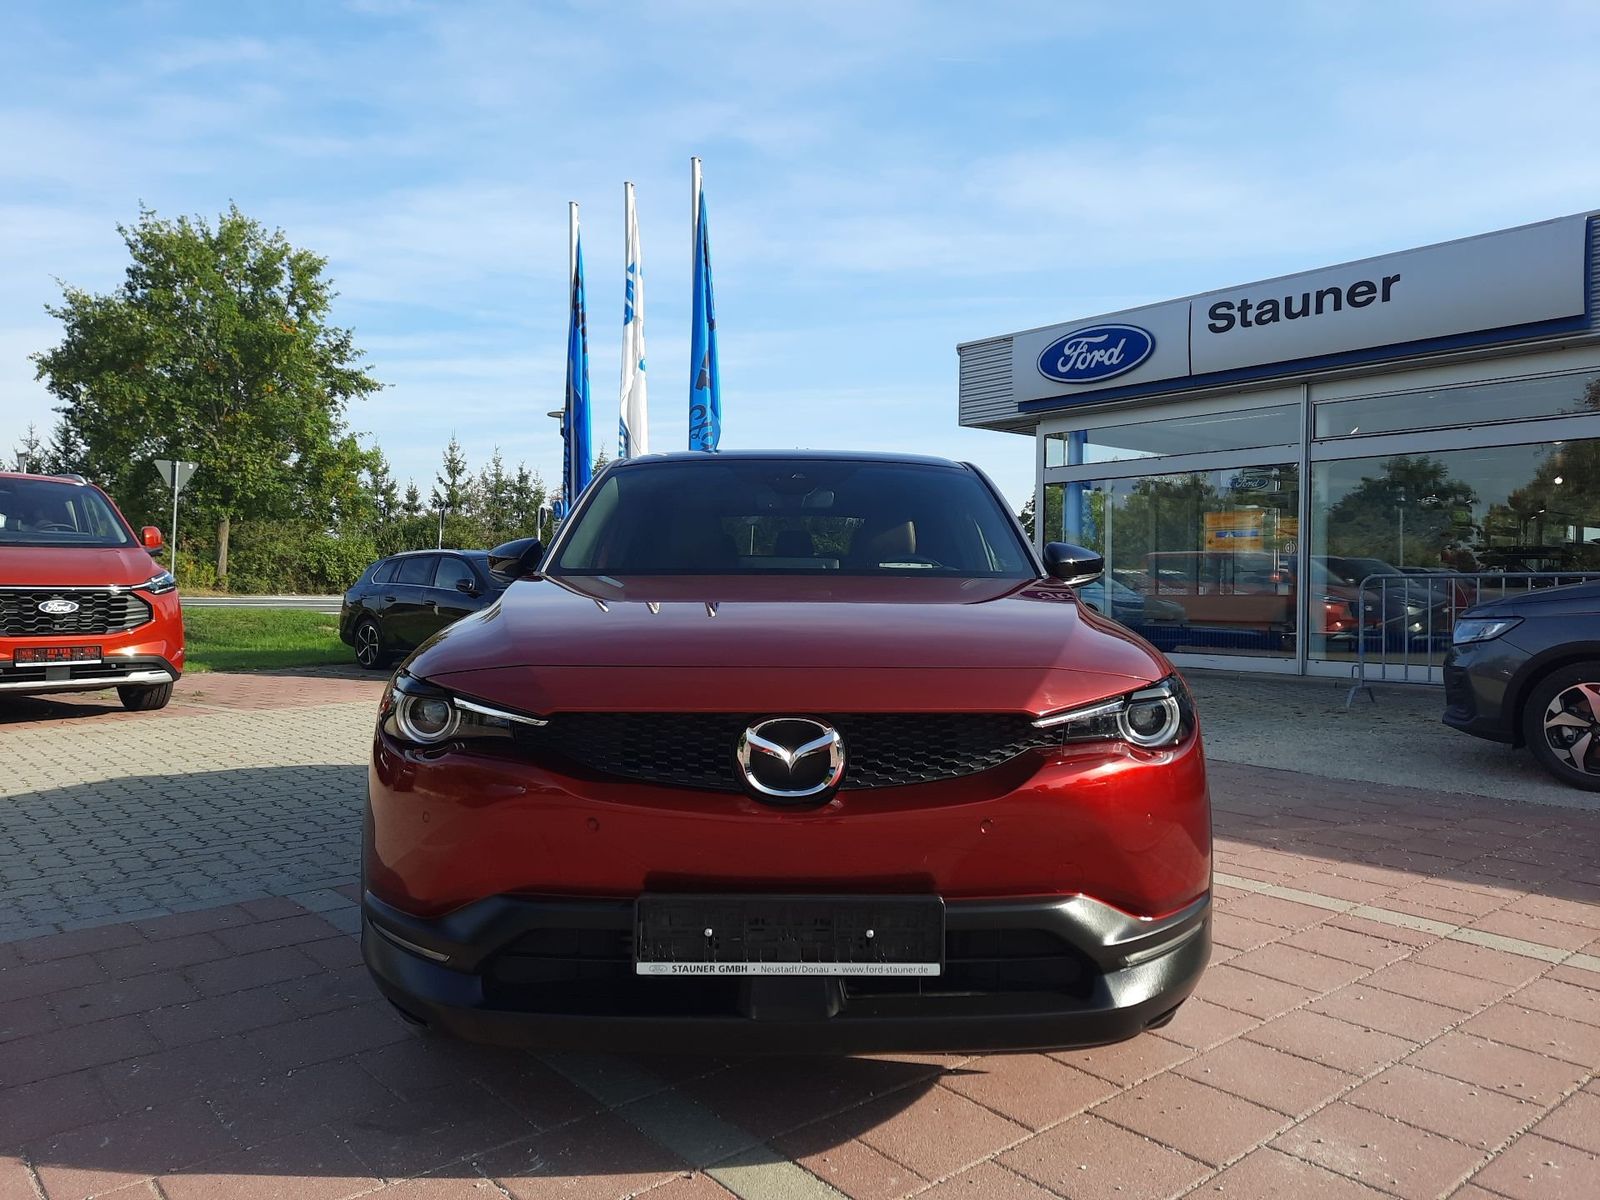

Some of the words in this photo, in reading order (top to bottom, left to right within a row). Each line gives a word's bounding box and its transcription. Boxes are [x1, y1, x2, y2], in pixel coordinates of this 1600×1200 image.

[1208, 273, 1401, 334] Stauner
[1057, 333, 1126, 373] Ford
[671, 964, 716, 973] STAUNER
[718, 964, 748, 973] GMBH
[760, 964, 829, 974] Neustadt/Donau
[842, 964, 929, 975] www.ford-stauner.de
